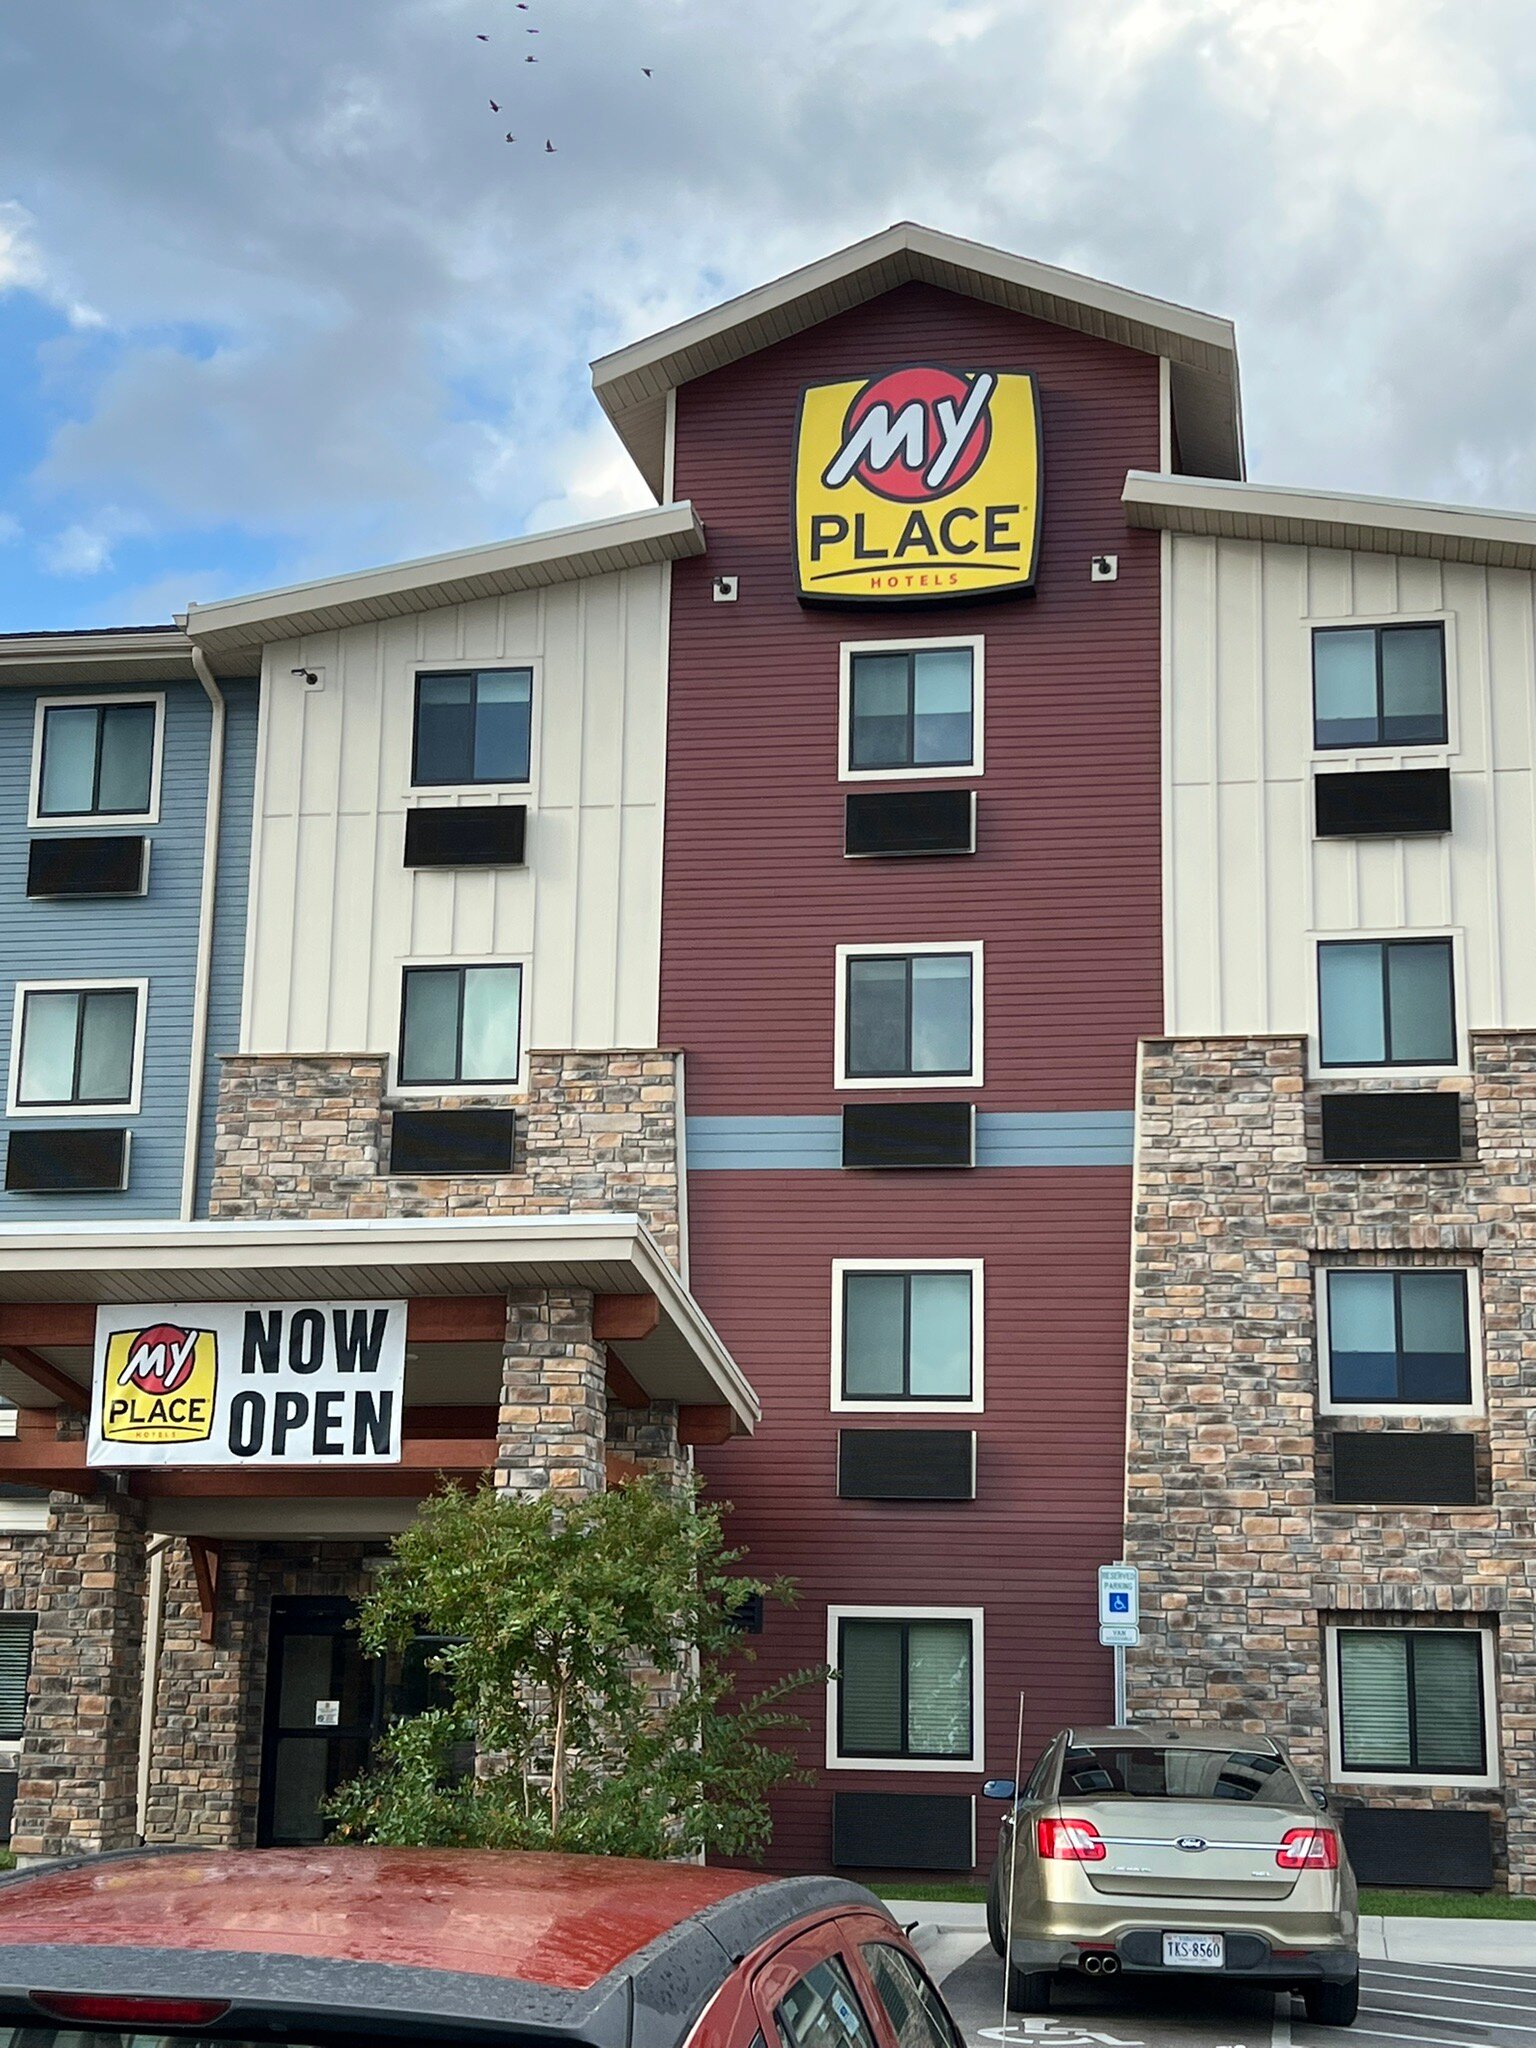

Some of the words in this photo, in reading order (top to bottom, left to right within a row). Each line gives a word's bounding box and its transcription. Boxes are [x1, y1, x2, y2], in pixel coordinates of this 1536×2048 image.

[810, 504, 1021, 562] PLACE
[870, 573, 958, 589] HOTELS
[241, 1308, 389, 1374] NOW
[109, 1398, 206, 1423] PLACE
[228, 1390, 394, 1457] OPEN
[1102, 1571, 1136, 1580] RESERVED
[1104, 1582, 1133, 1590] PARKING
